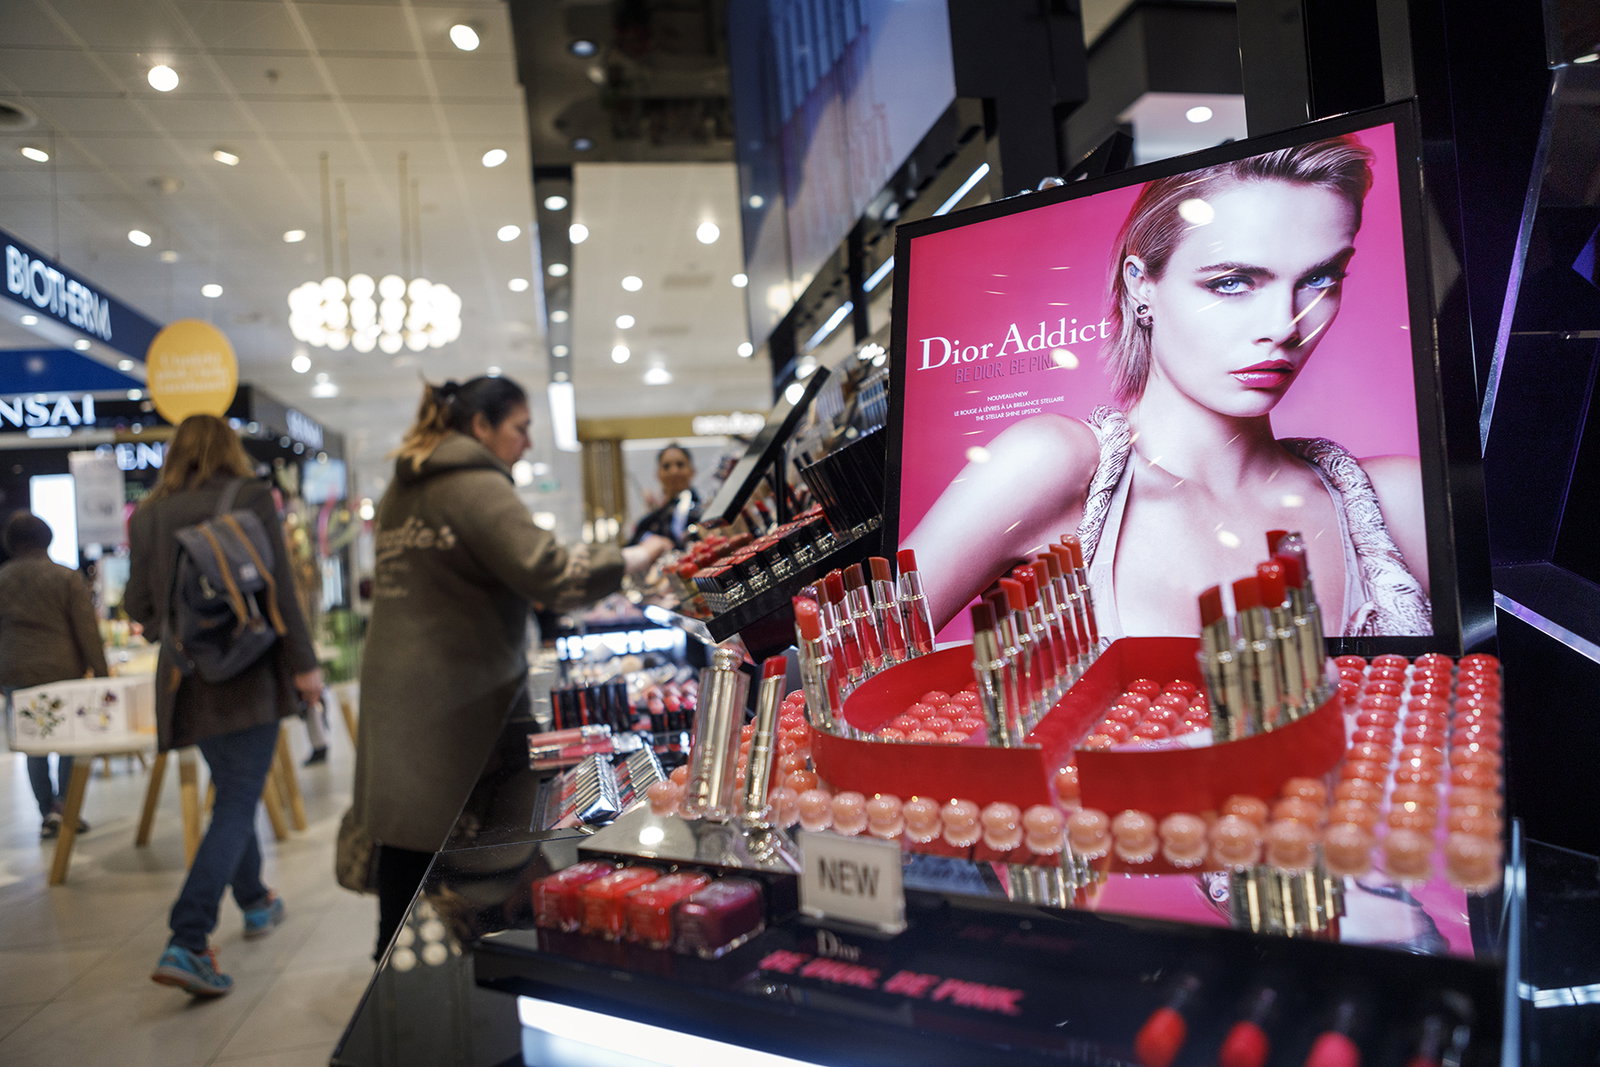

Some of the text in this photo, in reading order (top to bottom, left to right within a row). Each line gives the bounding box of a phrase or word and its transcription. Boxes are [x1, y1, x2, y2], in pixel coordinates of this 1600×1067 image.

[6, 245, 112, 340] BIOTHERM
[917, 317, 1112, 371] Dior Addict
[955, 367, 971, 384] BE
[1010, 358, 1026, 375] BE
[1029, 354, 1061, 373] PIN
[0, 394, 96, 428] NSAI
[960, 408, 978, 416] ROUGE
[817, 857, 879, 898] NEW
